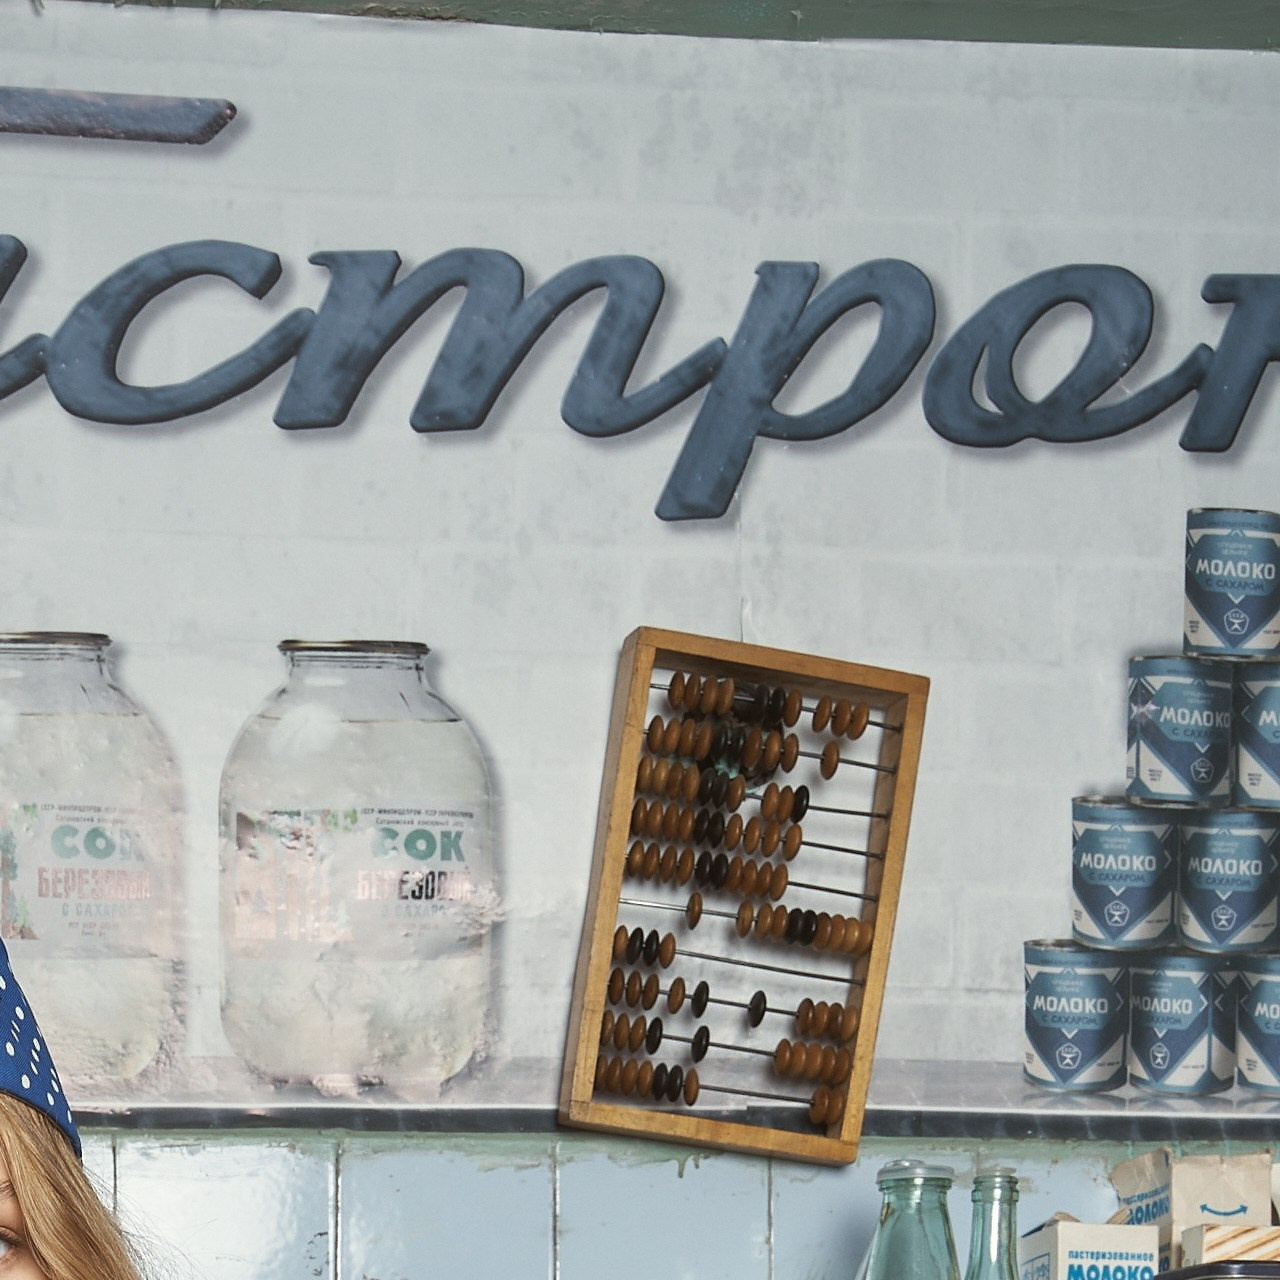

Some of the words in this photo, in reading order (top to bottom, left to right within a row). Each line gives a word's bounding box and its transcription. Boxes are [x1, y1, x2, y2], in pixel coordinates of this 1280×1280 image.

[1195, 558, 1276, 579] МОЛОКО
[1160, 706, 1231, 727] МОЛОКО
[51, 824, 145, 862] СОК
[371, 827, 465, 862] СОК
[1080, 852, 1157, 871] МОЛОКО
[1188, 856, 1263, 875] МОЛОКО
[1033, 995, 1108, 1014] МОЛОКО
[1131, 994, 1194, 1015] МОЛОКО
[1068, 1250, 1154, 1262] пастеризованное
